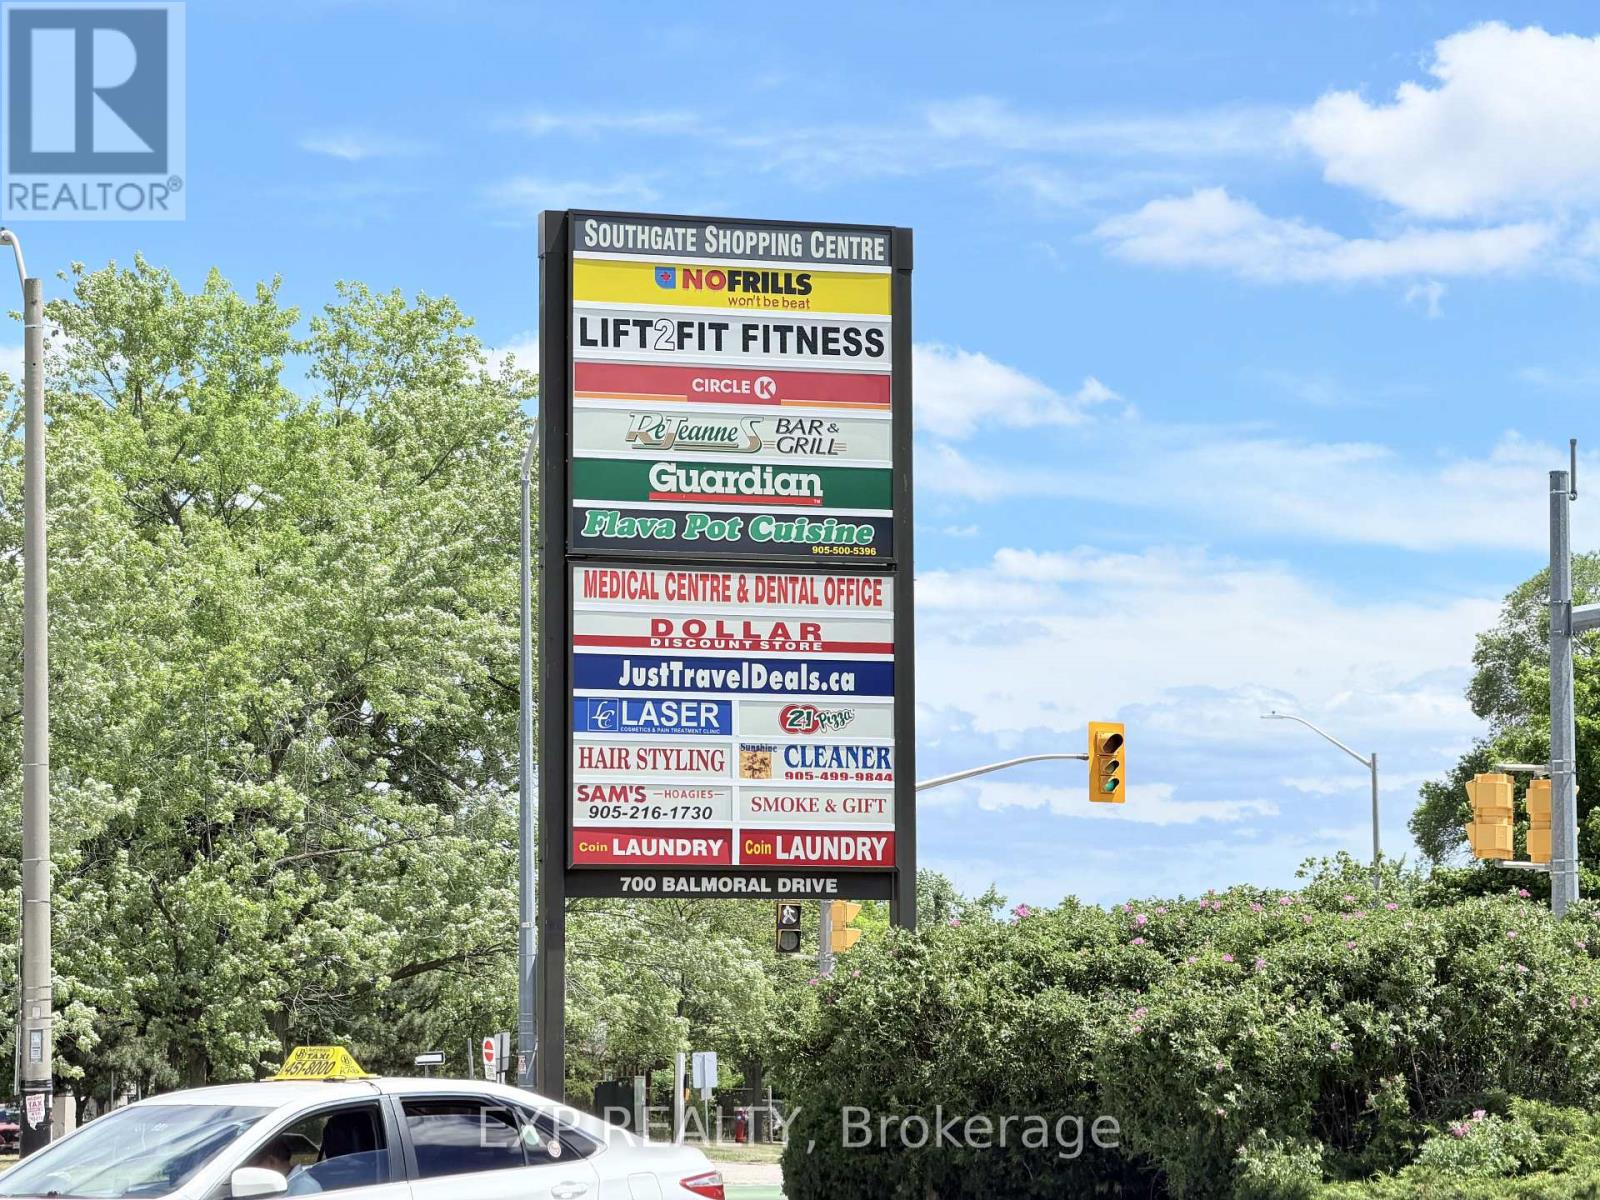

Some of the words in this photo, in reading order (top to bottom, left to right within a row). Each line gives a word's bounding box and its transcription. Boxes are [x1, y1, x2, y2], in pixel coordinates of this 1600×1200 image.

[585, 219, 696, 252] SOUTHGATE
[705, 225, 802, 256] SHOPPING
[811, 231, 884, 261] CENTRE
[728, 295, 760, 307] won't
[764, 296, 780, 308] be
[782, 298, 810, 310] beat
[580, 317, 728, 352] LIFT2FIT
[742, 324, 884, 357] FITNESS
[692, 378, 750, 394] CIRCLE
[757, 377, 776, 398] K
[776, 418, 823, 436] BAR
[827, 422, 840, 433] &
[776, 436, 838, 455] GRILL
[650, 462, 823, 497] Guardian
[581, 510, 676, 539] Flava
[683, 513, 742, 542] Pot
[750, 516, 874, 544] Cuisine
[812, 546, 876, 556] 905-500-5396
[584, 570, 659, 600] MEDICAL
[665, 572, 731, 602] CENTRE
[737, 575, 749, 603] &
[755, 576, 818, 605] DENTAL
[824, 576, 882, 606] OFFICE
[651, 618, 822, 640] DOLLAR
[650, 638, 752, 650] DISCOUNT
[760, 640, 823, 651] STORE
[619, 660, 855, 692] JustTravelDeals.ca
[622, 701, 720, 728] LASER
[816, 708, 852, 730] Pizza
[740, 743, 778, 752] Sunshine
[784, 744, 892, 770] CLEANER
[578, 746, 630, 770] HAIR
[636, 747, 725, 772] STYLING
[785, 771, 893, 782] 905-499-9844
[577, 784, 647, 802] SAM'S
[664, 789, 714, 800] HOAGIES
[588, 805, 712, 820] 905-216-1730
[751, 796, 818, 813] SMOKE
[826, 798, 836, 814] &
[842, 798, 886, 814] GIFT
[579, 842, 608, 852] Coin
[612, 838, 724, 856] LAUNDRY
[745, 840, 772, 856] Coin
[776, 836, 887, 860] LAUNDRY
[620, 876, 656, 892] 700
[662, 877, 771, 893] BALMORAL
[778, 878, 838, 893] DRIVE
[307, 1052, 330, 1060] TAXI
